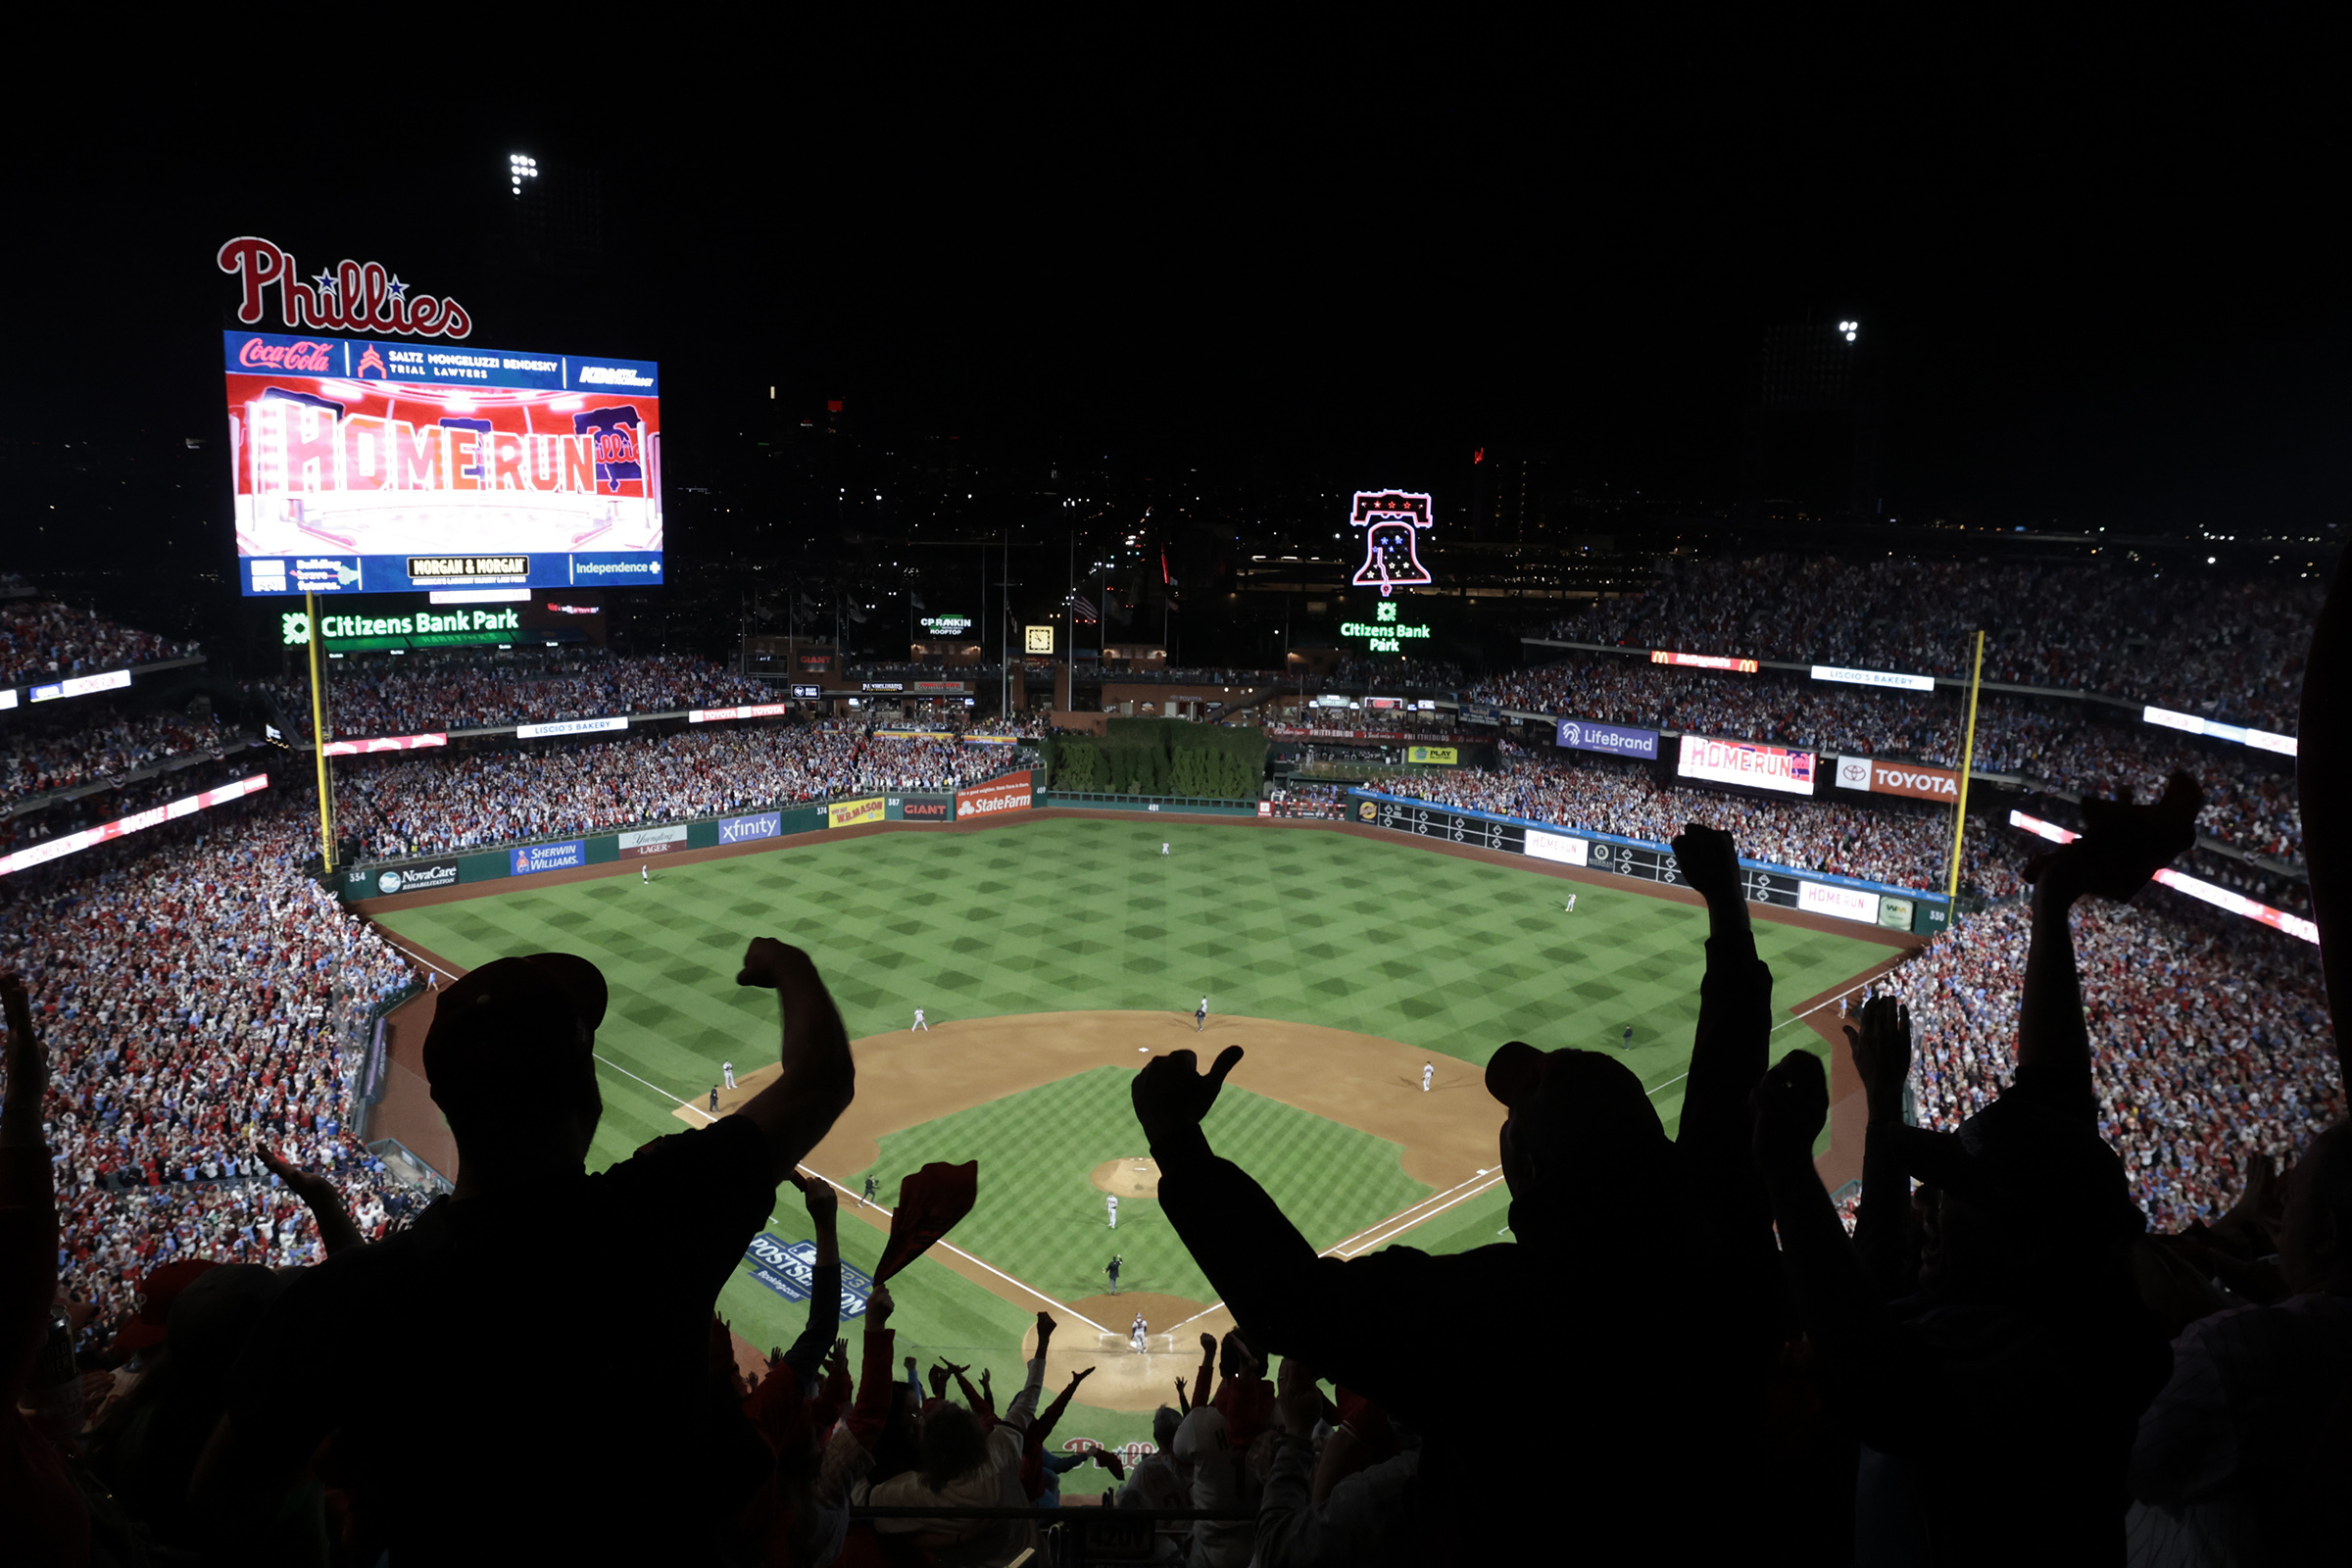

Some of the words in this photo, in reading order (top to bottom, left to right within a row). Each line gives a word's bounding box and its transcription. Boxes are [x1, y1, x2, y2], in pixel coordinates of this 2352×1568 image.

[217, 235, 471, 339] Phillies
[239, 337, 333, 371] Coca-Cola
[389, 351, 423, 364] SALTZ
[428, 354, 500, 368] MONGELUZZI
[503, 359, 558, 372] BENDESKY
[389, 365, 425, 375] TRIAL
[434, 368, 487, 379] LAWYERS
[414, 560, 463, 574] MORGAN
[466, 560, 474, 573] &
[477, 559, 524, 573] MORGAN
[576, 562, 648, 575] Independence
[321, 615, 413, 637] Citizens
[416, 610, 470, 634] Bank
[472, 608, 519, 630] Park
[1341, 622, 1395, 638] Citizens
[1396, 624, 1430, 638] Bank
[1369, 638, 1399, 652] Park
[1677, 654, 1731, 667] McDonald's
[1830, 670, 1872, 682] LISCIO'S
[1875, 674, 1914, 686] BAKERY
[703, 707, 737, 720] TOYOTA
[751, 703, 785, 717] TOYOTA
[534, 723, 573, 734] LISCIO'S
[575, 720, 612, 731] BAKERY
[1585, 729, 1653, 752] LifeBrand
[1691, 738, 1750, 771] HOME
[1753, 751, 1793, 778] RUN
[1875, 769, 1958, 794] TOYOTA
[888, 798, 900, 807] 387
[904, 804, 947, 814] GIANT
[816, 807, 827, 815] 374
[722, 818, 777, 842] xfinity
[632, 831, 674, 846] Yuengling
[1533, 834, 1558, 851] HOME
[1560, 841, 1577, 854] RUN
[530, 845, 576, 860] SHERWIN
[639, 843, 668, 855] LAGER
[349, 872, 367, 882] 334
[402, 866, 457, 883] NovaCare
[402, 876, 455, 891] REHABILITATION
[1808, 886, 1841, 905] HOME
[1844, 894, 1864, 908] RUN
[758, 1270, 800, 1298] Booking.com
